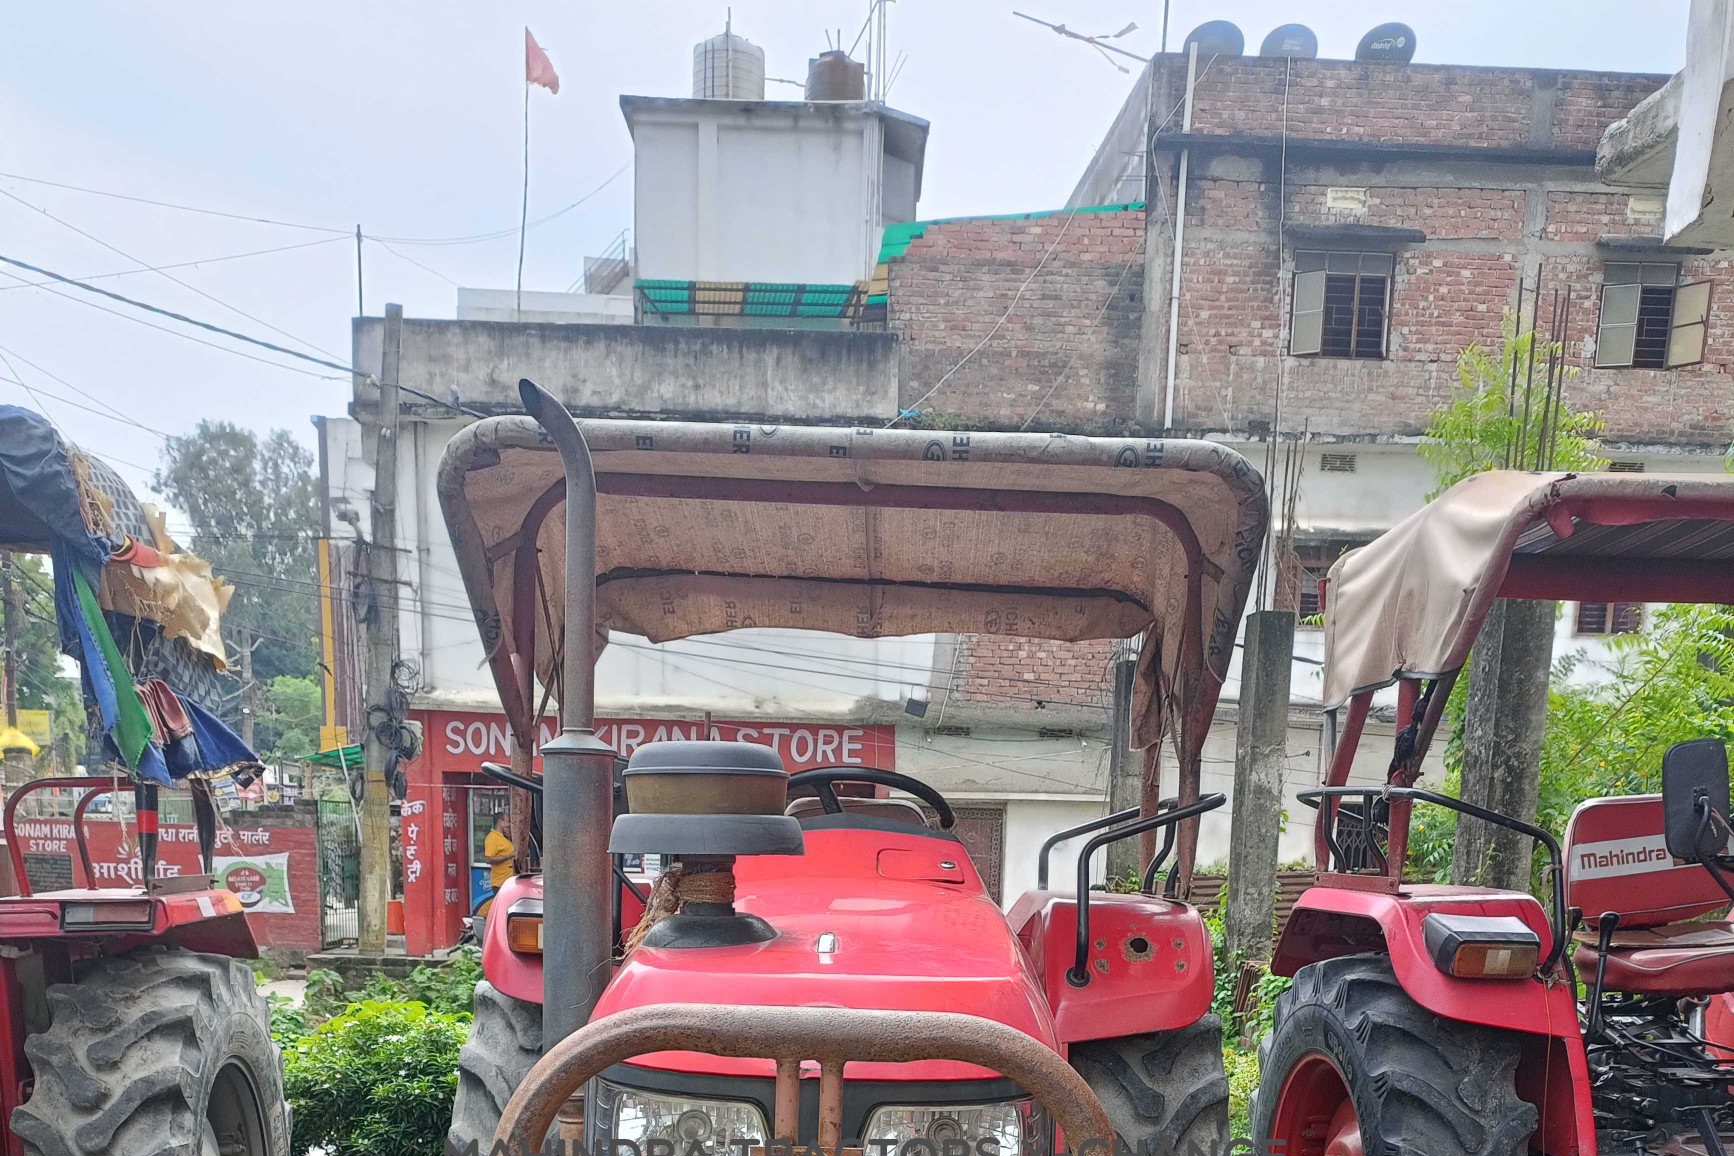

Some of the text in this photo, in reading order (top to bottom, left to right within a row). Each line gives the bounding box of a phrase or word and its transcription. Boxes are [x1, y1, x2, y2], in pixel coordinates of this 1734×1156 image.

[445, 721, 558, 757] SON
[52, 823, 89, 839] KIRAA
[29, 839, 67, 852] STORE
[1580, 846, 1667, 870] Mahindra
